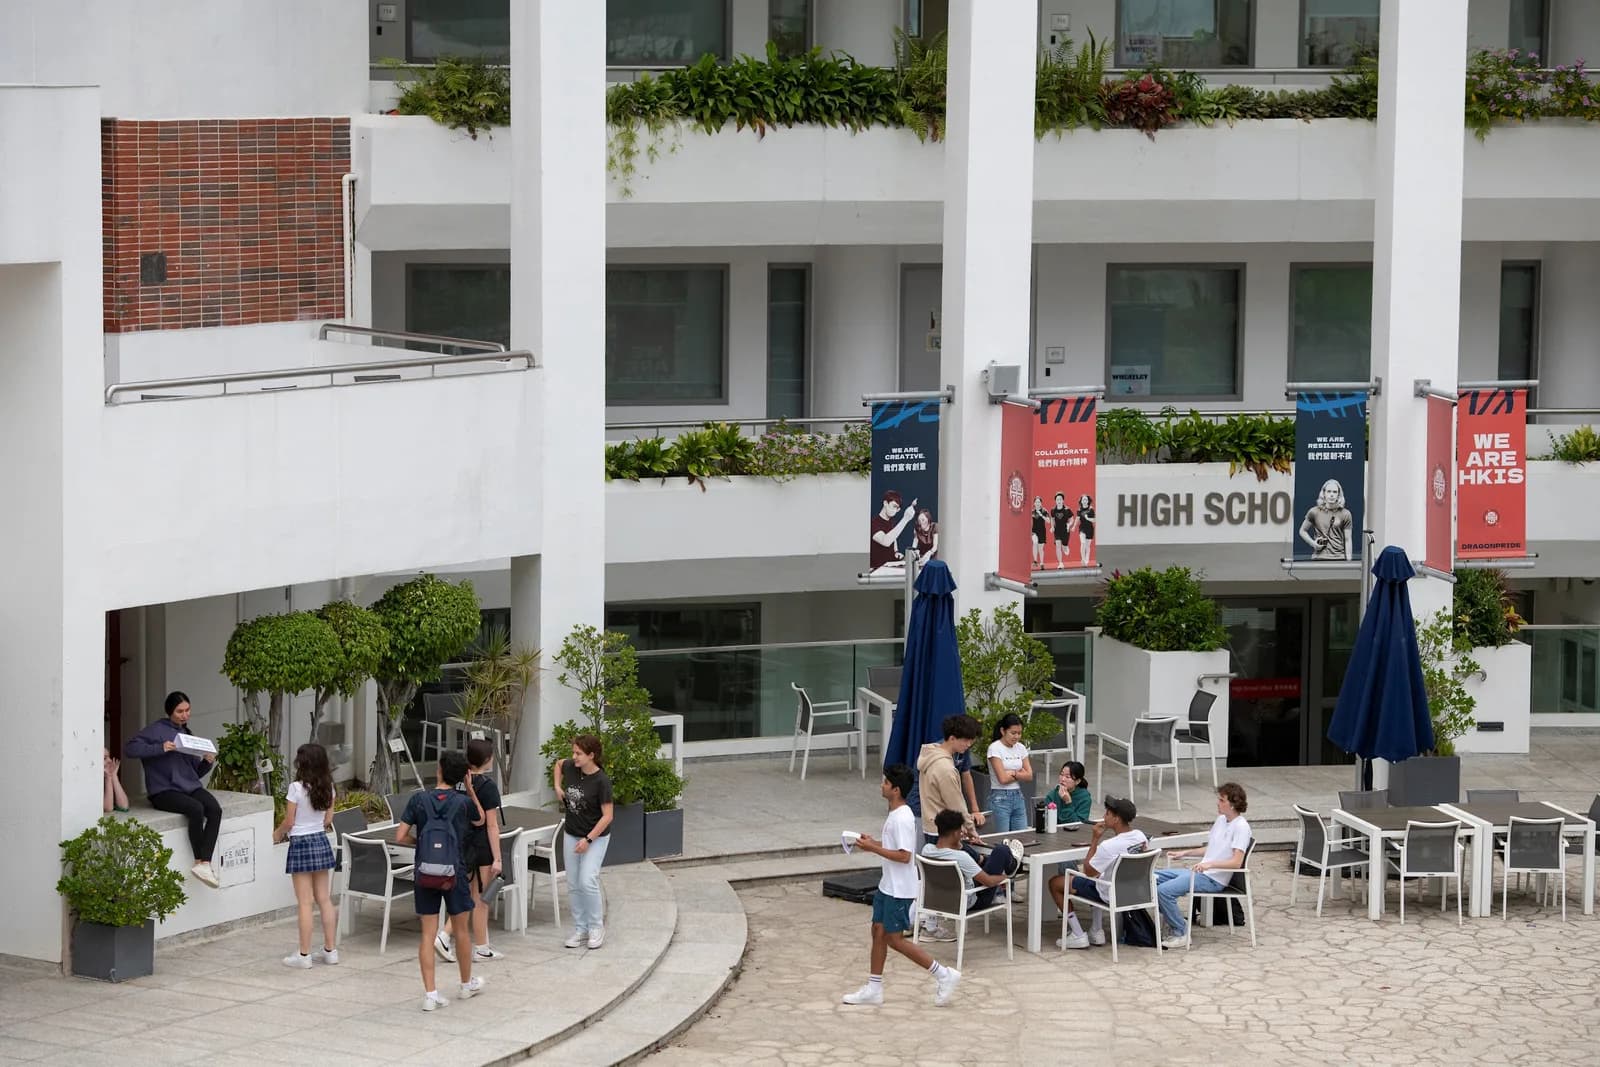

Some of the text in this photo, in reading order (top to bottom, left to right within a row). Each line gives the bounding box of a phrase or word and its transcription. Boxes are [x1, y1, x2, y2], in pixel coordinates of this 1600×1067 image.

[1473, 433, 1510, 449] WE
[1034, 448, 1091, 456] COLLABORATE.
[1465, 450, 1518, 467] ARE
[1459, 468, 1524, 485] HKIS
[1117, 490, 1292, 527] HIGH SCHO
[1461, 542, 1521, 550] DRAGONPRIDE
